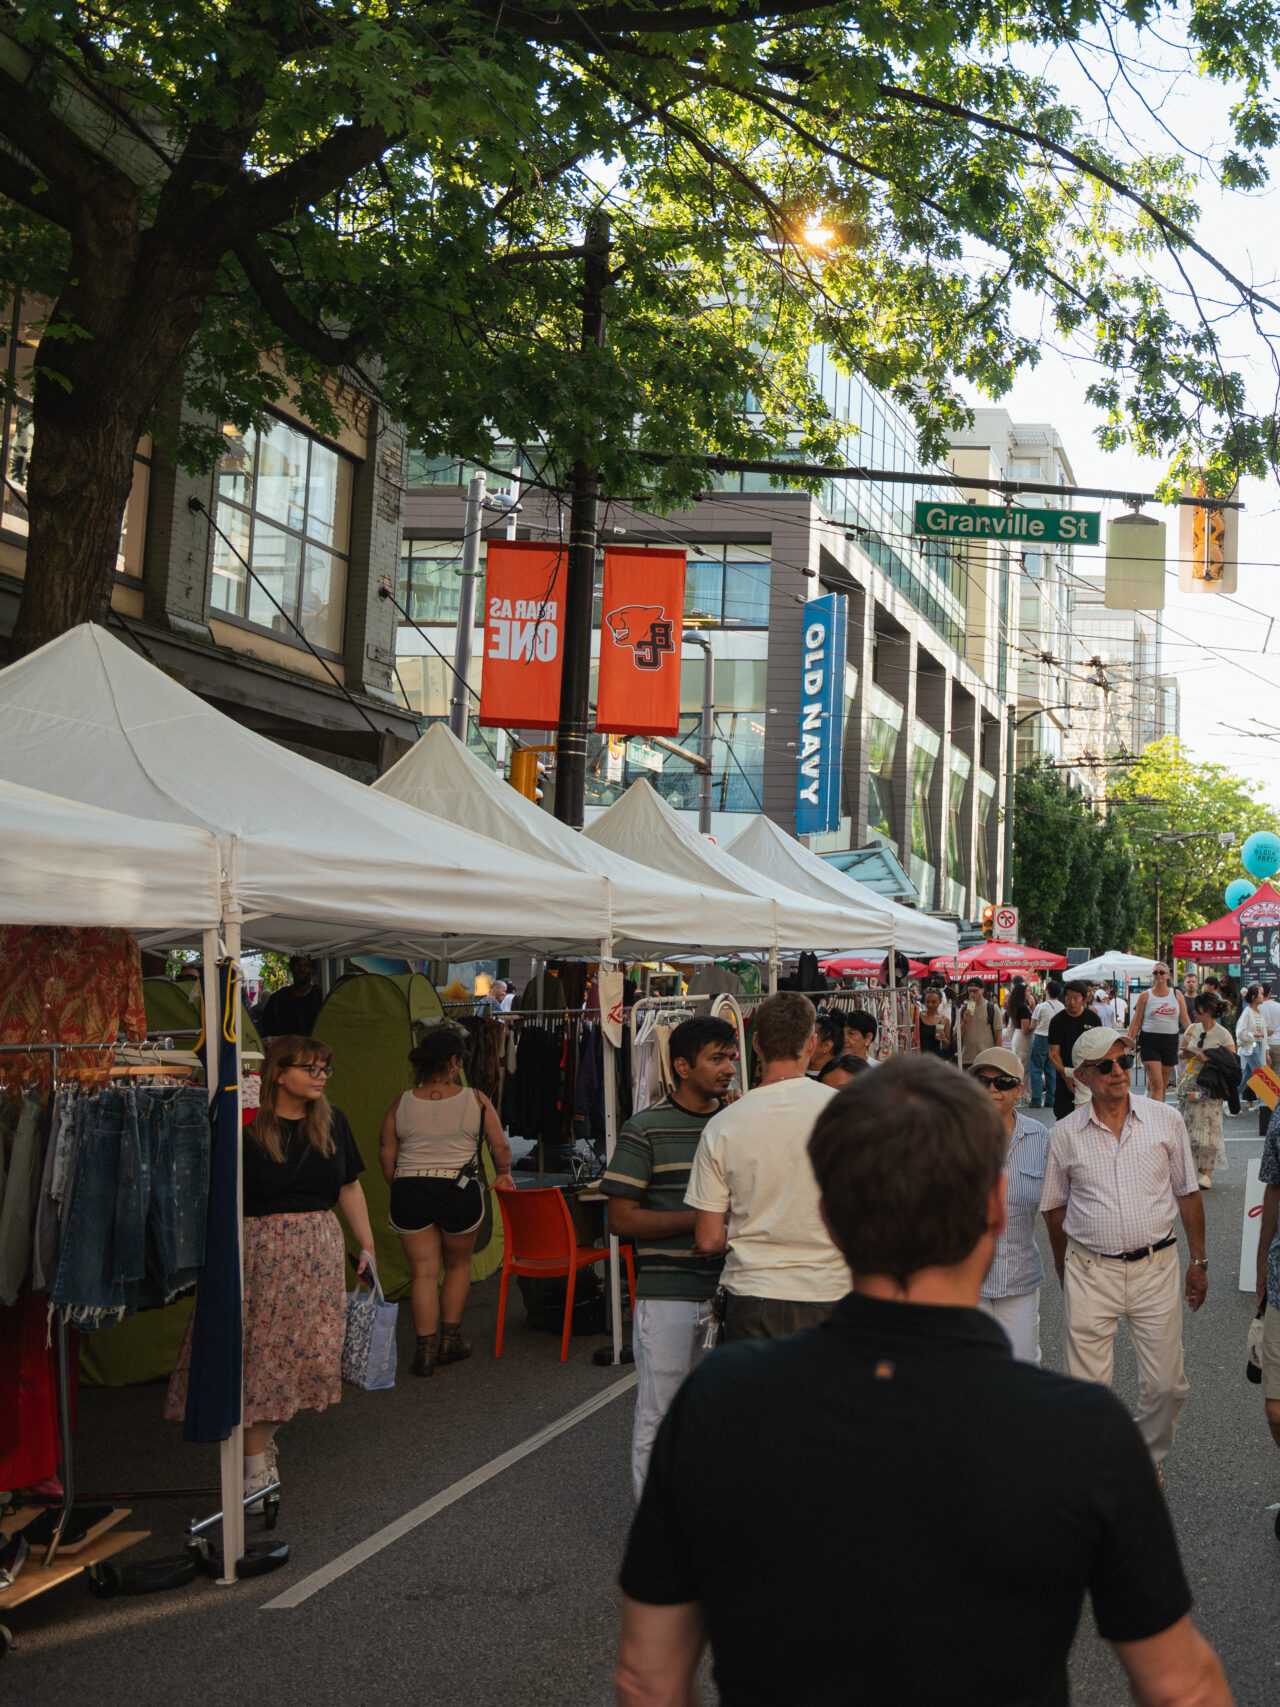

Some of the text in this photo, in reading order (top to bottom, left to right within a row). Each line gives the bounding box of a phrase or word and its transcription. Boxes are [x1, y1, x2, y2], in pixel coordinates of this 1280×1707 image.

[926, 507, 1088, 539] Granville St
[799, 622, 827, 806] OLD NAVY
[1190, 940, 1229, 952] RED
